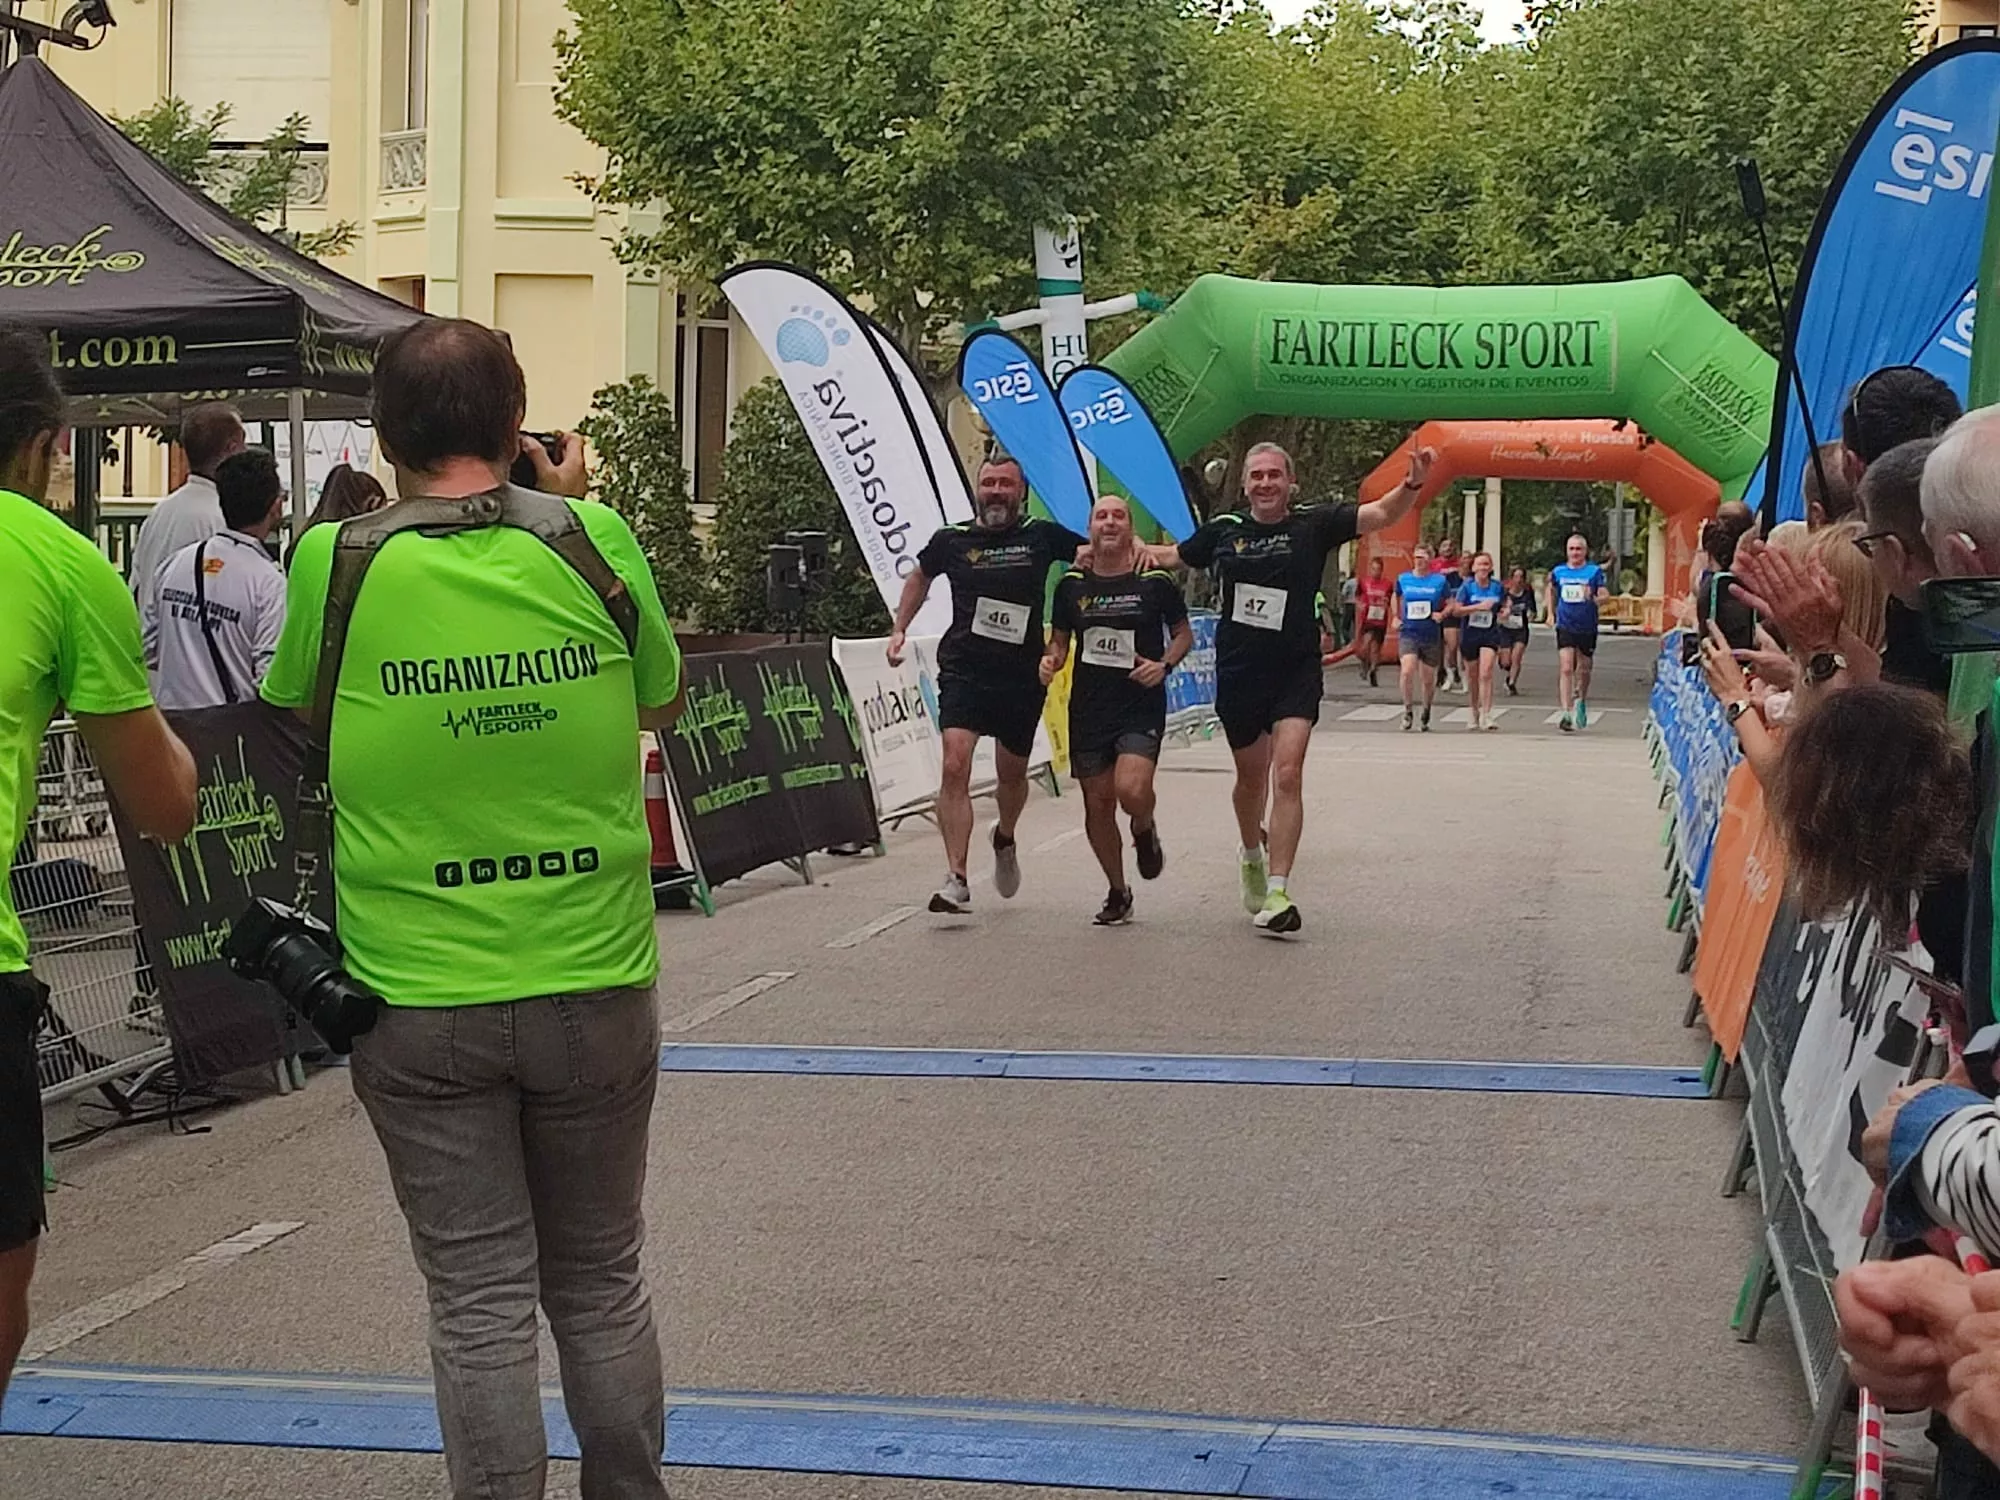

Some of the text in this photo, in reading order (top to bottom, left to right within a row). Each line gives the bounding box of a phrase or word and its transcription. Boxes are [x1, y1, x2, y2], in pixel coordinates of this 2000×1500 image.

[0, 225, 113, 265] leck
[1270, 318, 1600, 369] FARTLECK SPORT
[1515, 375, 1589, 389] EVENTOS
[1559, 430, 1576, 442] de
[1580, 431, 1634, 445] Huesca
[1245, 598, 1267, 612] 47
[988, 611, 1010, 625] 46
[380, 637, 599, 697] ORGANIZACIÓN
[477, 702, 542, 719] FARTLECK
[483, 717, 544, 736] SPORT
